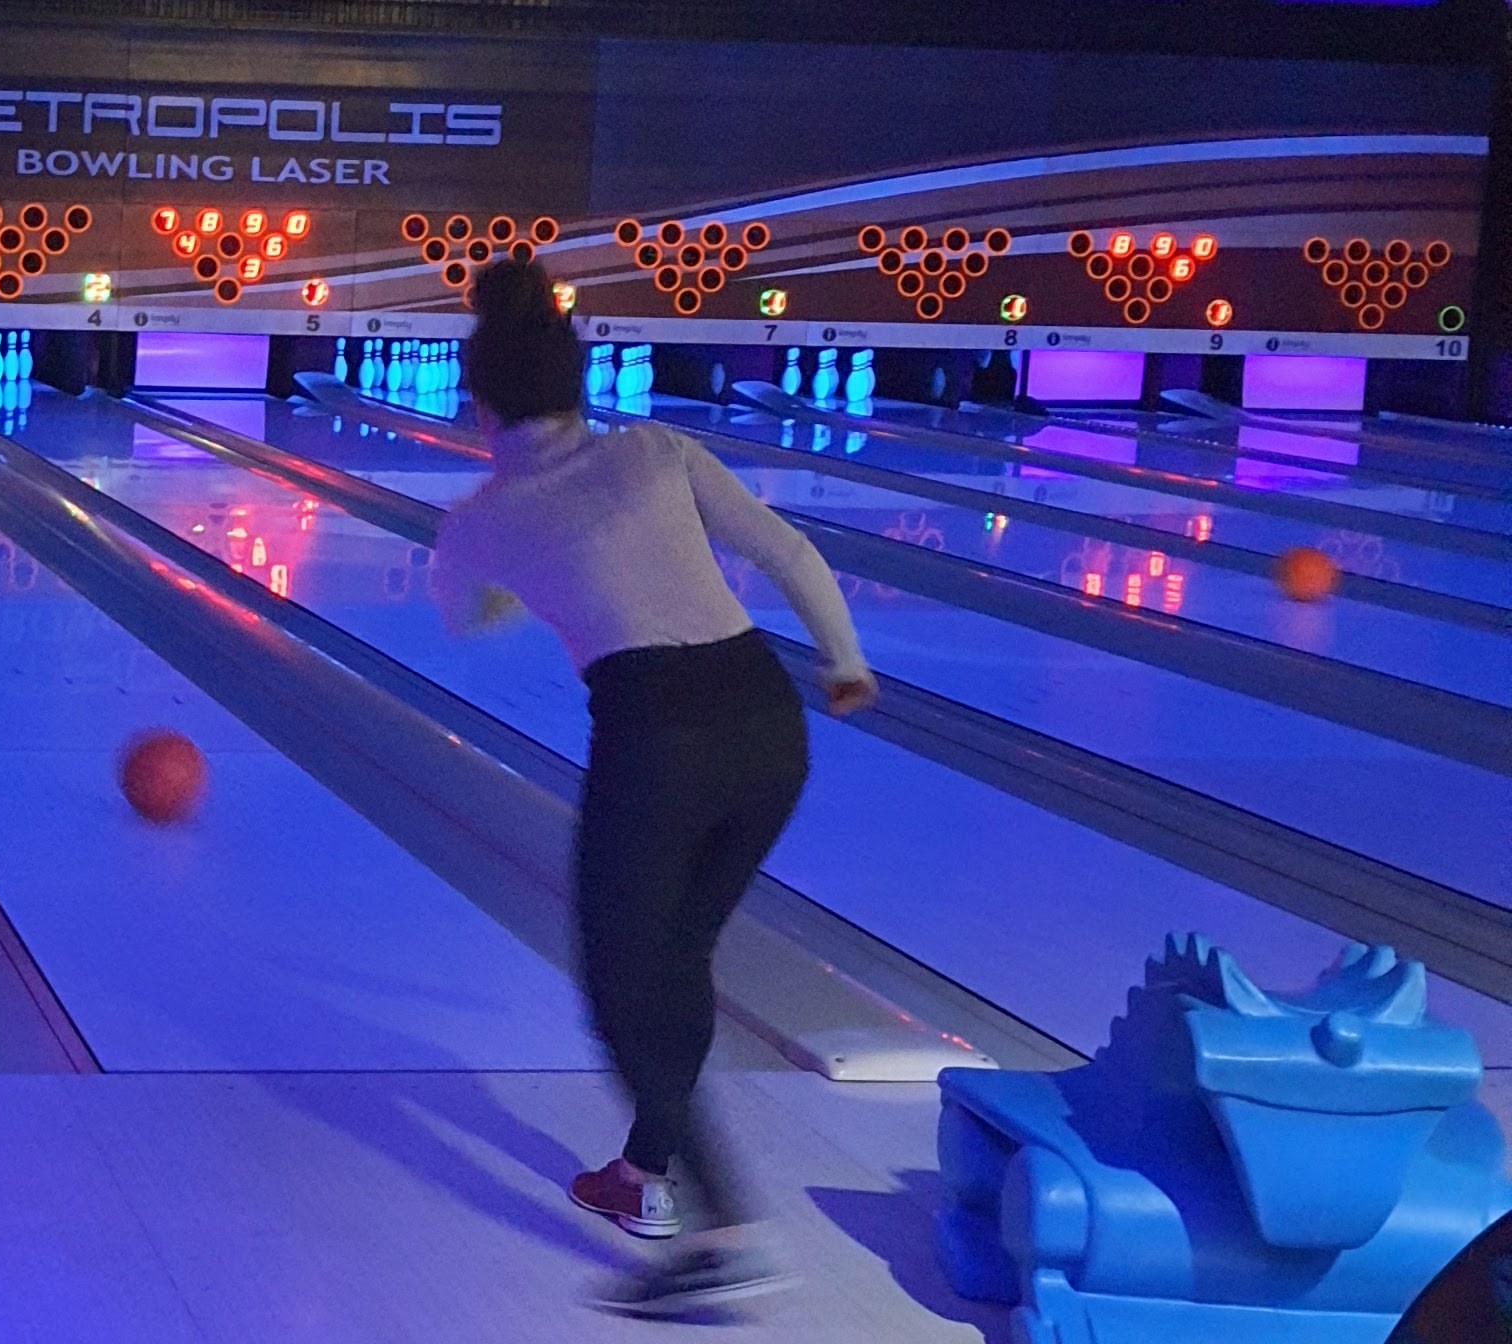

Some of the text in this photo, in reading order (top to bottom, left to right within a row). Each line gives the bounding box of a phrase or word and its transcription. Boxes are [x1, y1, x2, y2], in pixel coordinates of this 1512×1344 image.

[16, 149, 391, 186] BOWLING LASER
[160, 211, 176, 230] 7
[201, 212, 219, 233] 8
[245, 213, 263, 233] 9
[179, 235, 282, 256] 4 6
[1113, 235, 1131, 254] 8
[1156, 236, 1172, 256] 9
[244, 258, 261, 278] 3
[1173, 259, 1190, 278] 6
[87, 309, 102, 327] 4
[306, 314, 320, 332] 5
[764, 325, 778, 342] 7
[1004, 329, 1018, 346] 8
[1210, 333, 1224, 351] 9
[1435, 340, 1462, 357] 10
